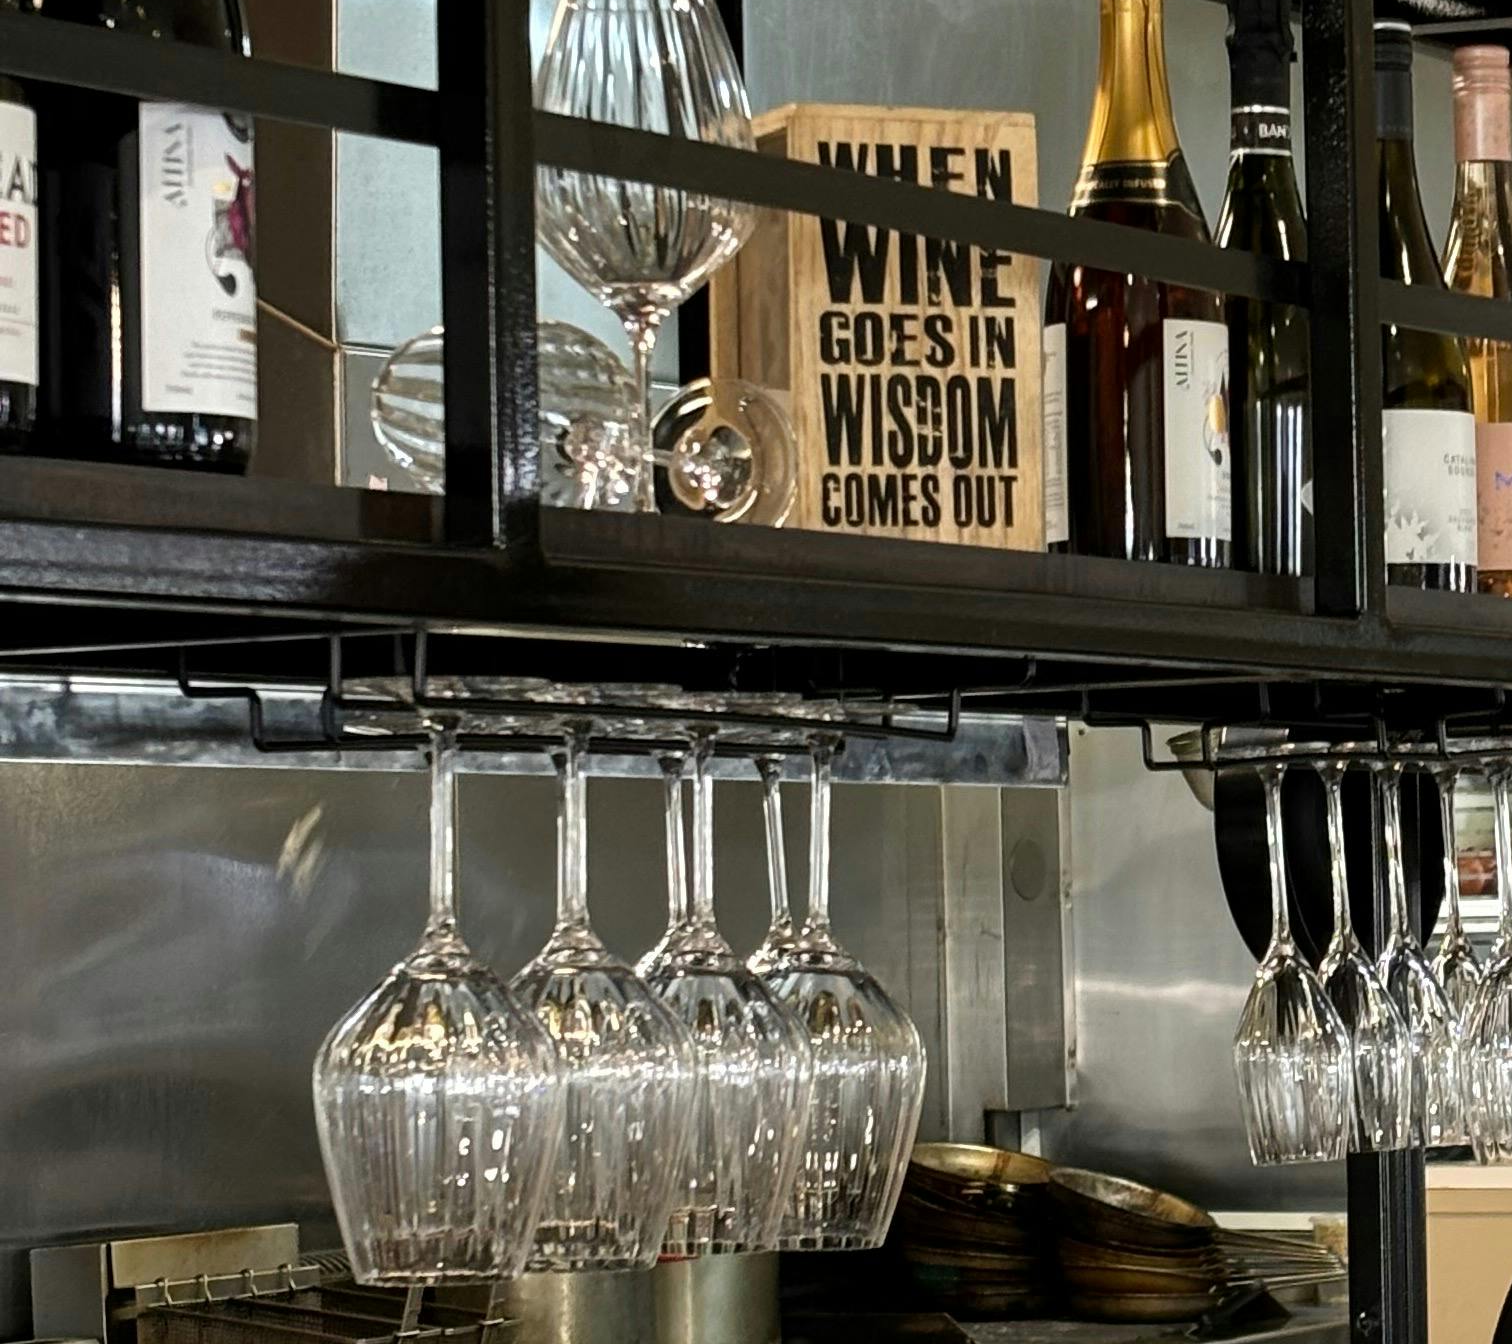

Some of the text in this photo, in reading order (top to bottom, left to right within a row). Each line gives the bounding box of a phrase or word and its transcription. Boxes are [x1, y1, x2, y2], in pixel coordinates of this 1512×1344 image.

[819, 213, 1017, 309] WINE
[819, 310, 1017, 370] GOES IN
[820, 372, 1019, 471] WISDOM
[821, 471, 1019, 529] COMES OUT
